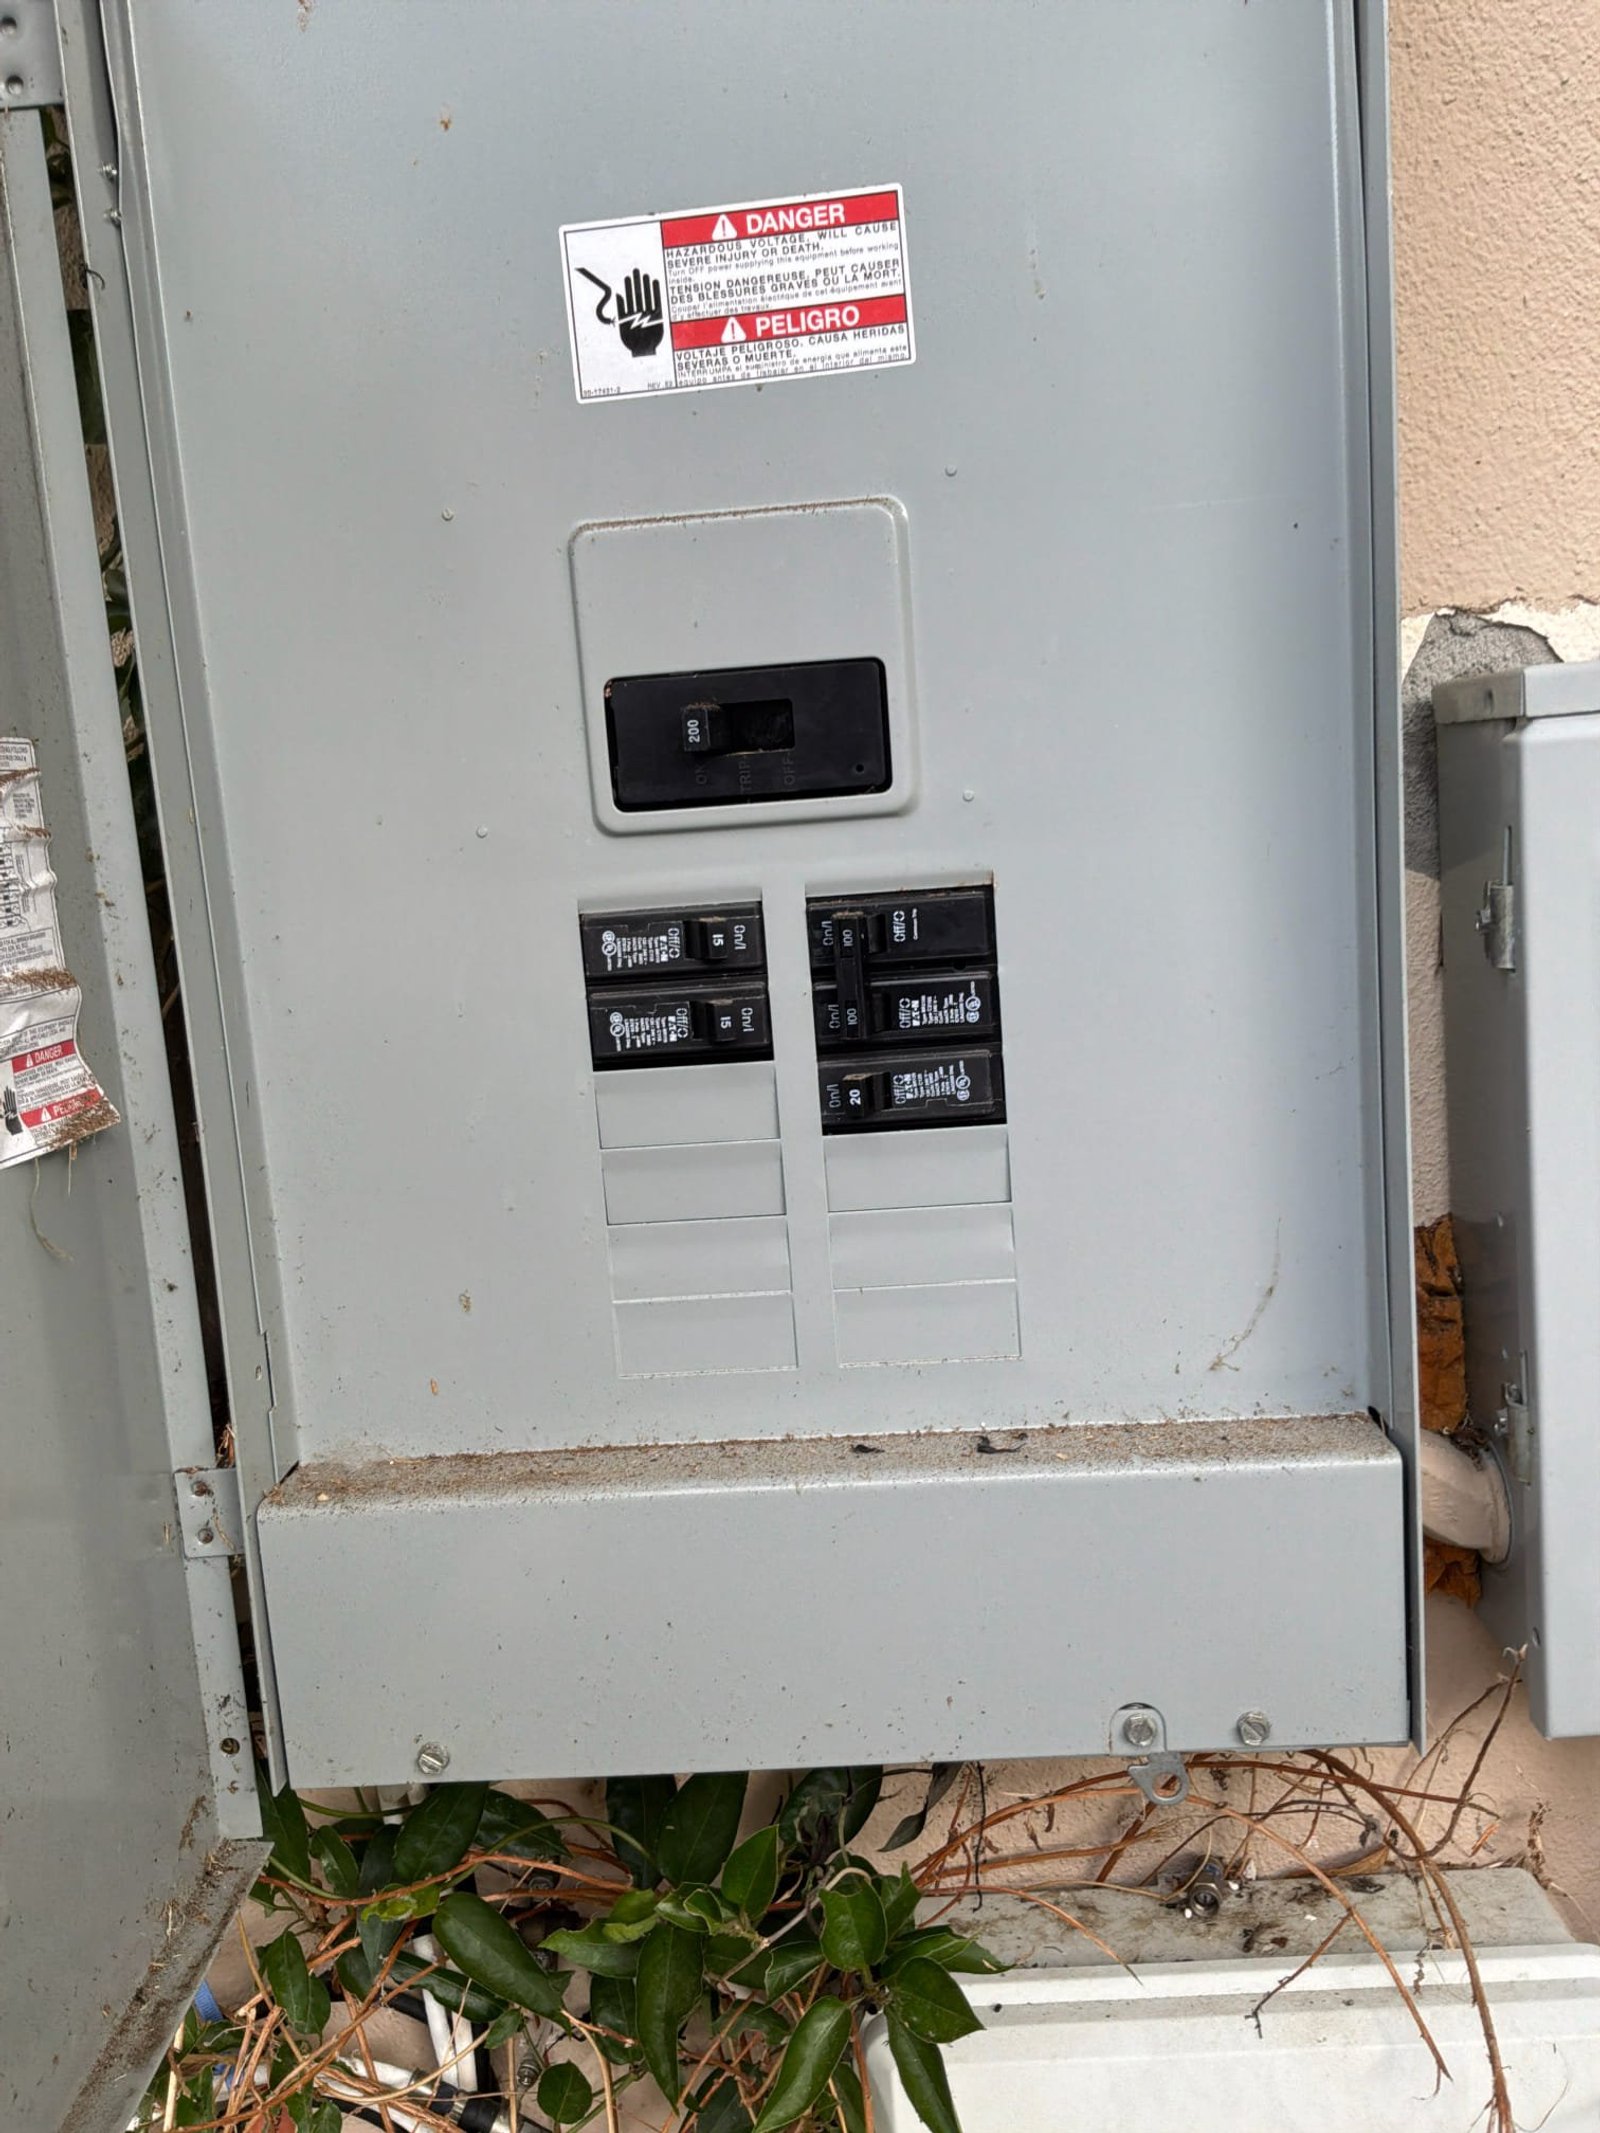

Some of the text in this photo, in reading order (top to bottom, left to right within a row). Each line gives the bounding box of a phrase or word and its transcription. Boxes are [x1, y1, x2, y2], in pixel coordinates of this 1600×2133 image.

[746, 203, 845, 234] DANGER
[666, 241, 741, 259] HAZARDOUS
[818, 228, 847, 240] WILL
[855, 222, 896, 235] CAUSE
[667, 241, 823, 269] SEVERE INJURY OR DEATH.
[708, 264, 732, 273] power
[735, 257, 773, 270] supplying
[795, 249, 837, 262] equipment
[841, 246, 863, 254] before
[868, 242, 898, 253] working
[670, 281, 721, 295] TENSION
[815, 265, 845, 277] PEUT
[851, 258, 899, 272] CAUSER
[671, 268, 900, 304] DES BLESSURES GRAVES OU LA MORT.
[756, 305, 860, 337] PELIGRO
[676, 347, 725, 361] VOLTAJE
[809, 332, 847, 345] CAUSA
[853, 325, 904, 339] HERIDAS
[836, 353, 849, 361] que
[853, 347, 886, 357] alimenta
[890, 344, 906, 352] este
[677, 348, 795, 371] SEVERAS O MUERTE.
[688, 719, 700, 743] 200
[739, 760, 753, 793] TRIP
[783, 758, 798, 785] OFF
[712, 933, 724, 946] 15
[842, 929, 854, 947] 100
[720, 1016, 732, 1028] 15
[847, 1008, 858, 1025] 100
[34, 1044, 63, 1063] DANGER
[848, 1089, 861, 1105] 20
